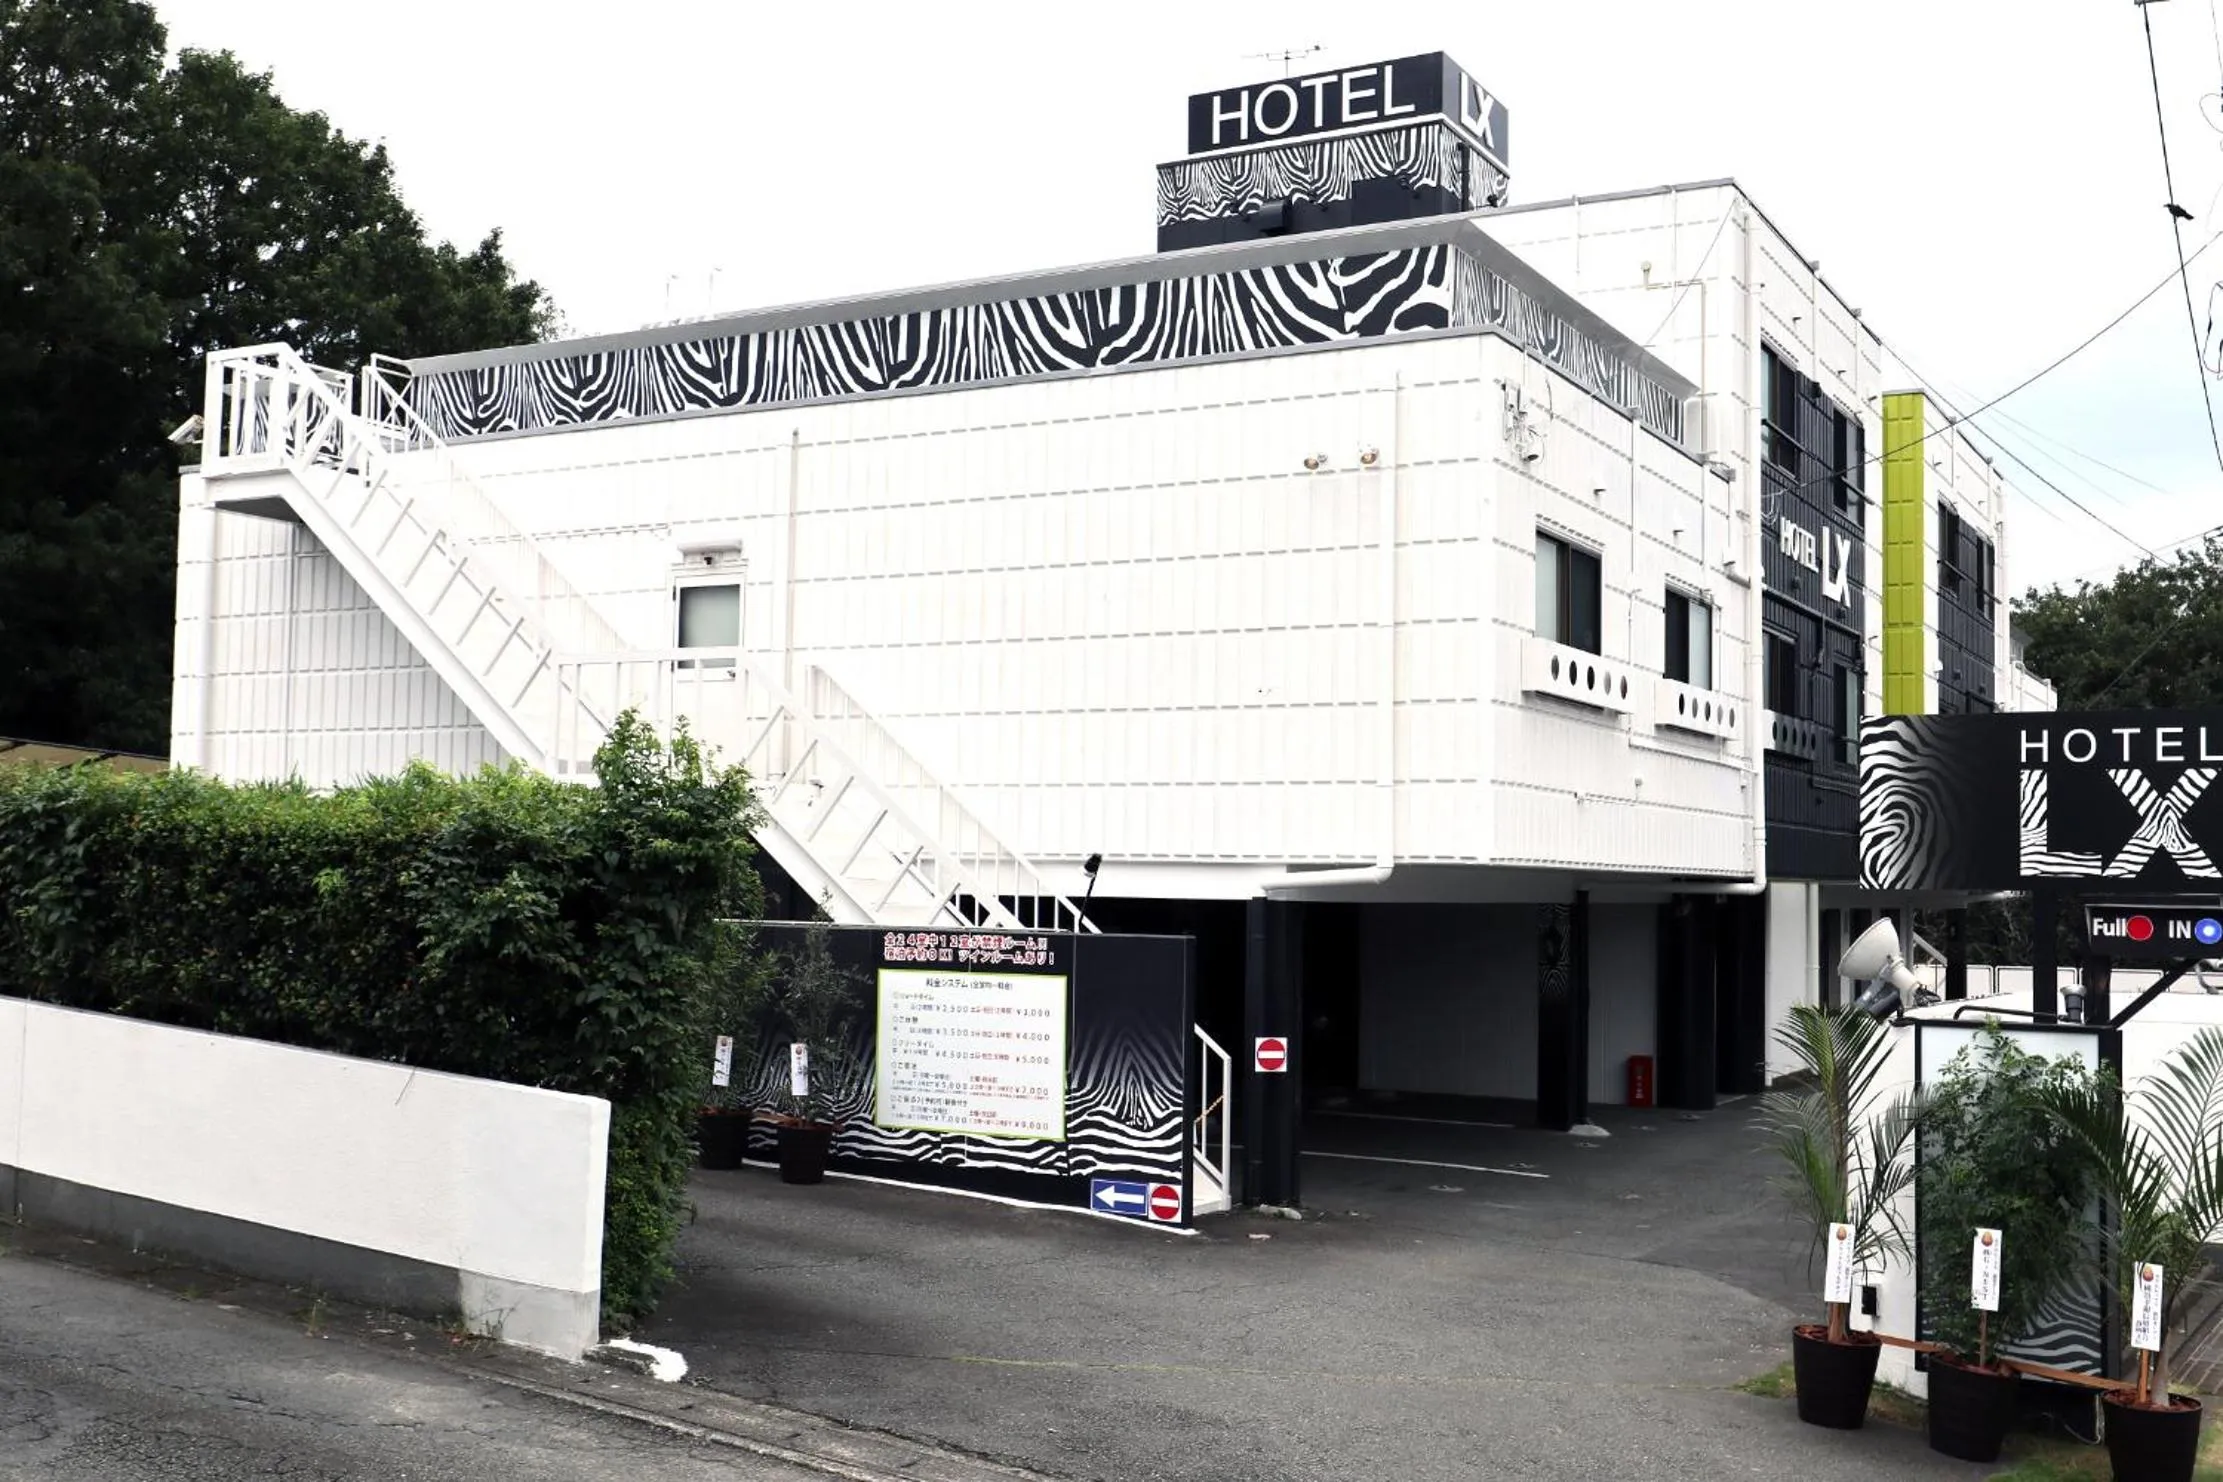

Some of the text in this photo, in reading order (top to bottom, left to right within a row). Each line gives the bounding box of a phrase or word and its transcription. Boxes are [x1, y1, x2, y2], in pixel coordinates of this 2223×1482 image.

[1212, 65, 1416, 145] HOTEL
[1460, 71, 1495, 149] LX
[1780, 516, 1851, 608] HOTEL LX
[2020, 727, 2223, 763] HOTEL
[2019, 768, 2223, 879] LX
[2093, 917, 2192, 939] Full IN
